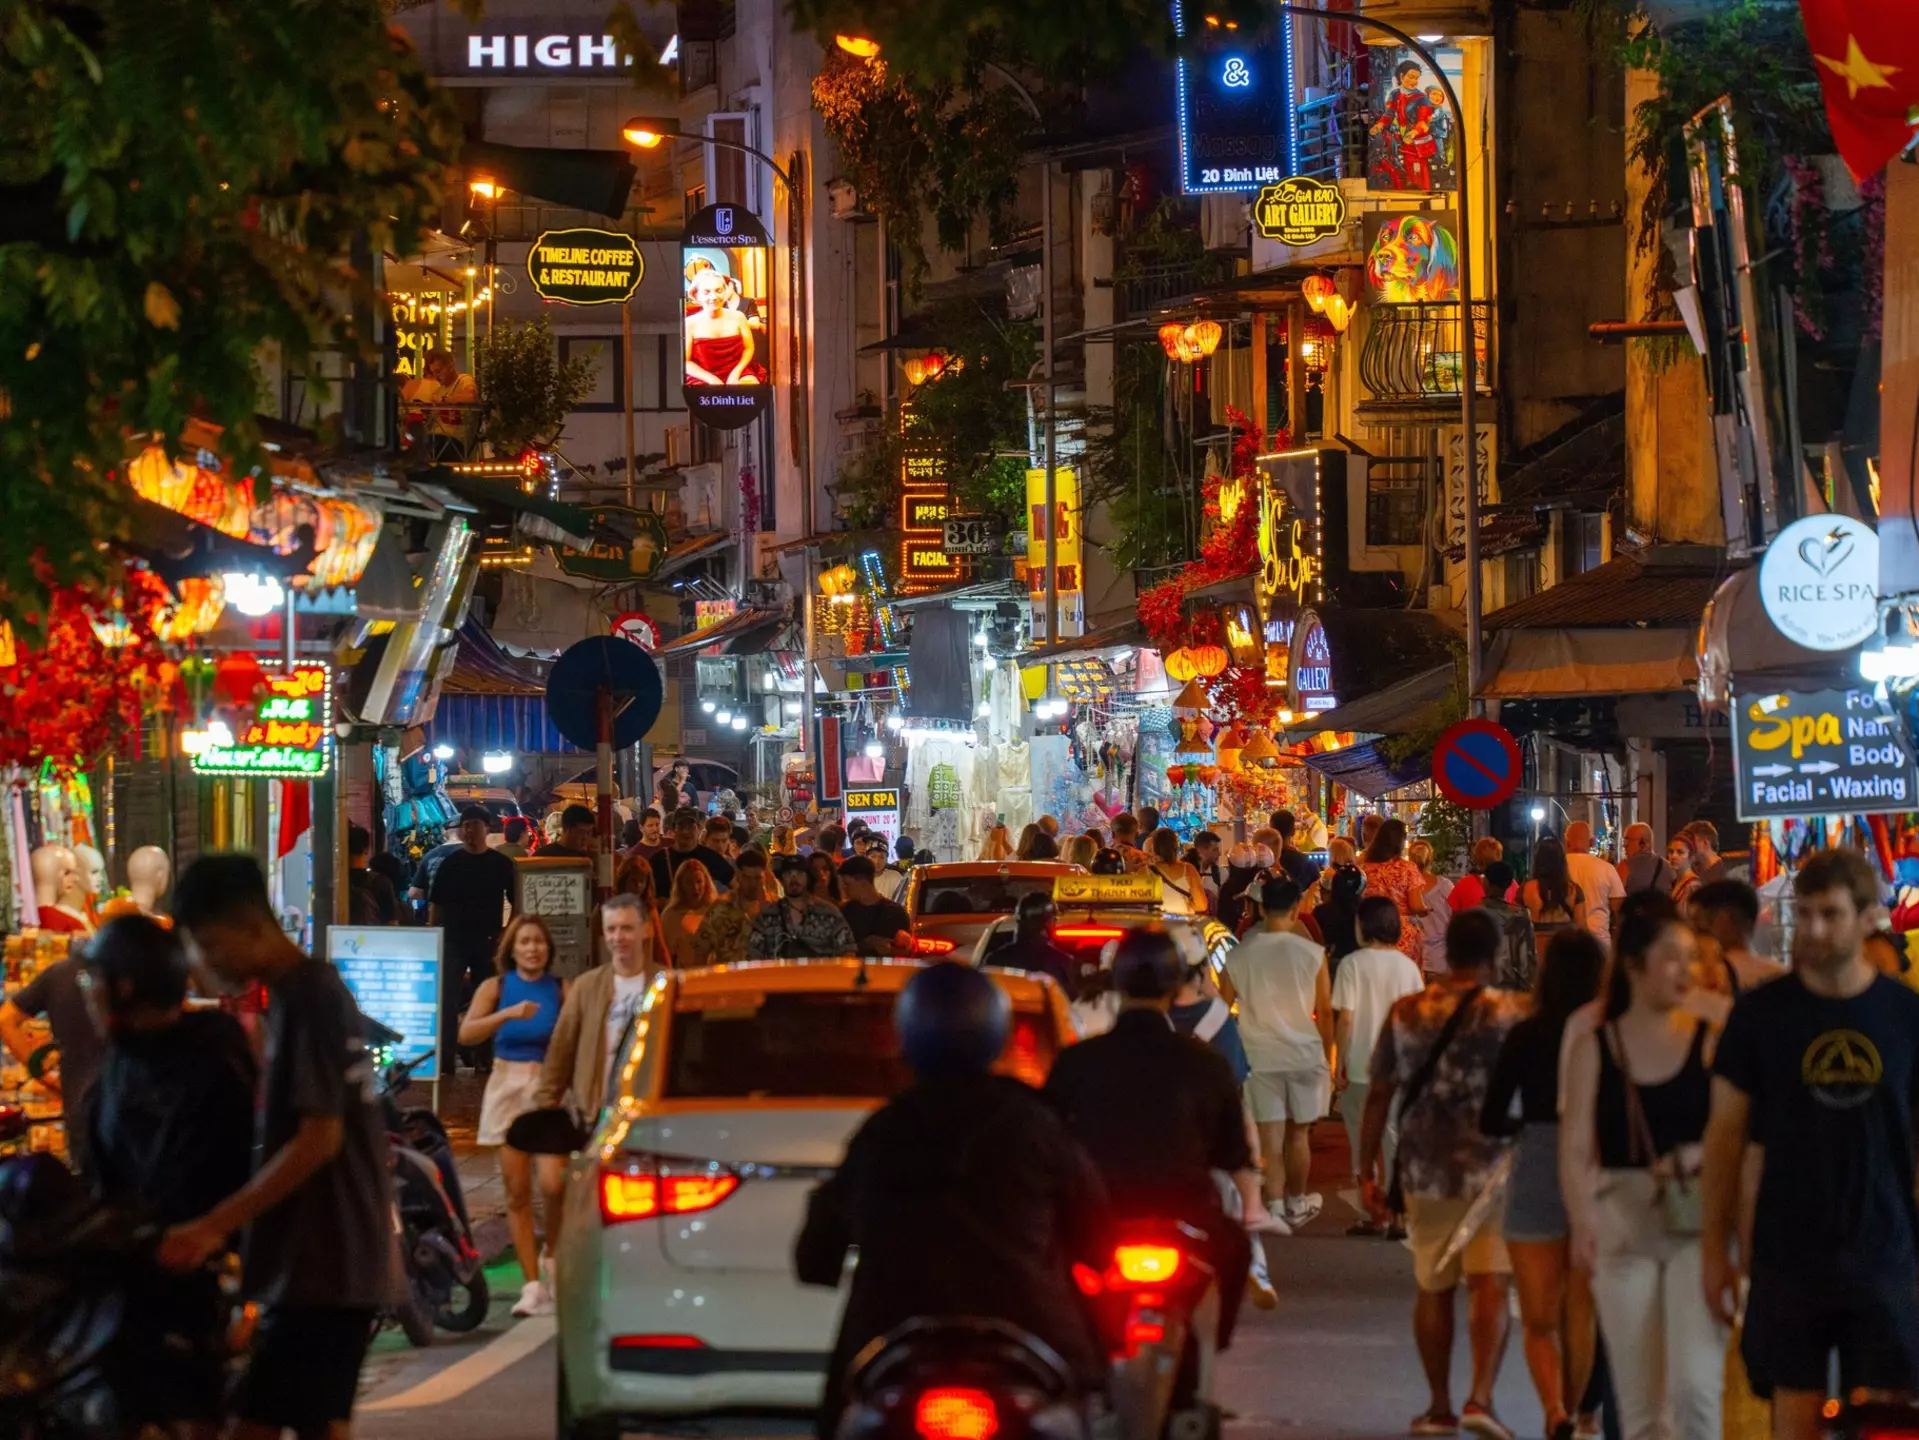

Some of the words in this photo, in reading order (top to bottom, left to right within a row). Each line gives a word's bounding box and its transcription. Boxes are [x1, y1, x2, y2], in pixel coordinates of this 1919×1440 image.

[468, 35, 678, 67] HIGH
[1222, 58, 1250, 87] &
[1201, 168, 1220, 183] 20
[1264, 204, 1287, 227] ART
[1289, 203, 1338, 226] GALLERY
[691, 235, 737, 244] L'essence
[738, 234, 757, 245] Spa
[538, 247, 590, 264] TIMELINE
[590, 249, 634, 266] COFFEE
[540, 268, 550, 285] &
[551, 269, 630, 287] RESTAURANT
[699, 396, 710, 405] 36
[913, 551, 950, 566] FACIAL
[1778, 584, 1826, 602] RICE
[1833, 583, 1876, 601] SPA
[1296, 667, 1330, 691] GALLERY
[1748, 694, 1843, 759] Spa
[1850, 742, 1905, 768] Body
[1752, 779, 1813, 804] Facial
[1829, 774, 1906, 800] Waxing
[848, 793, 870, 806] SEN
[873, 792, 896, 806] SPA
